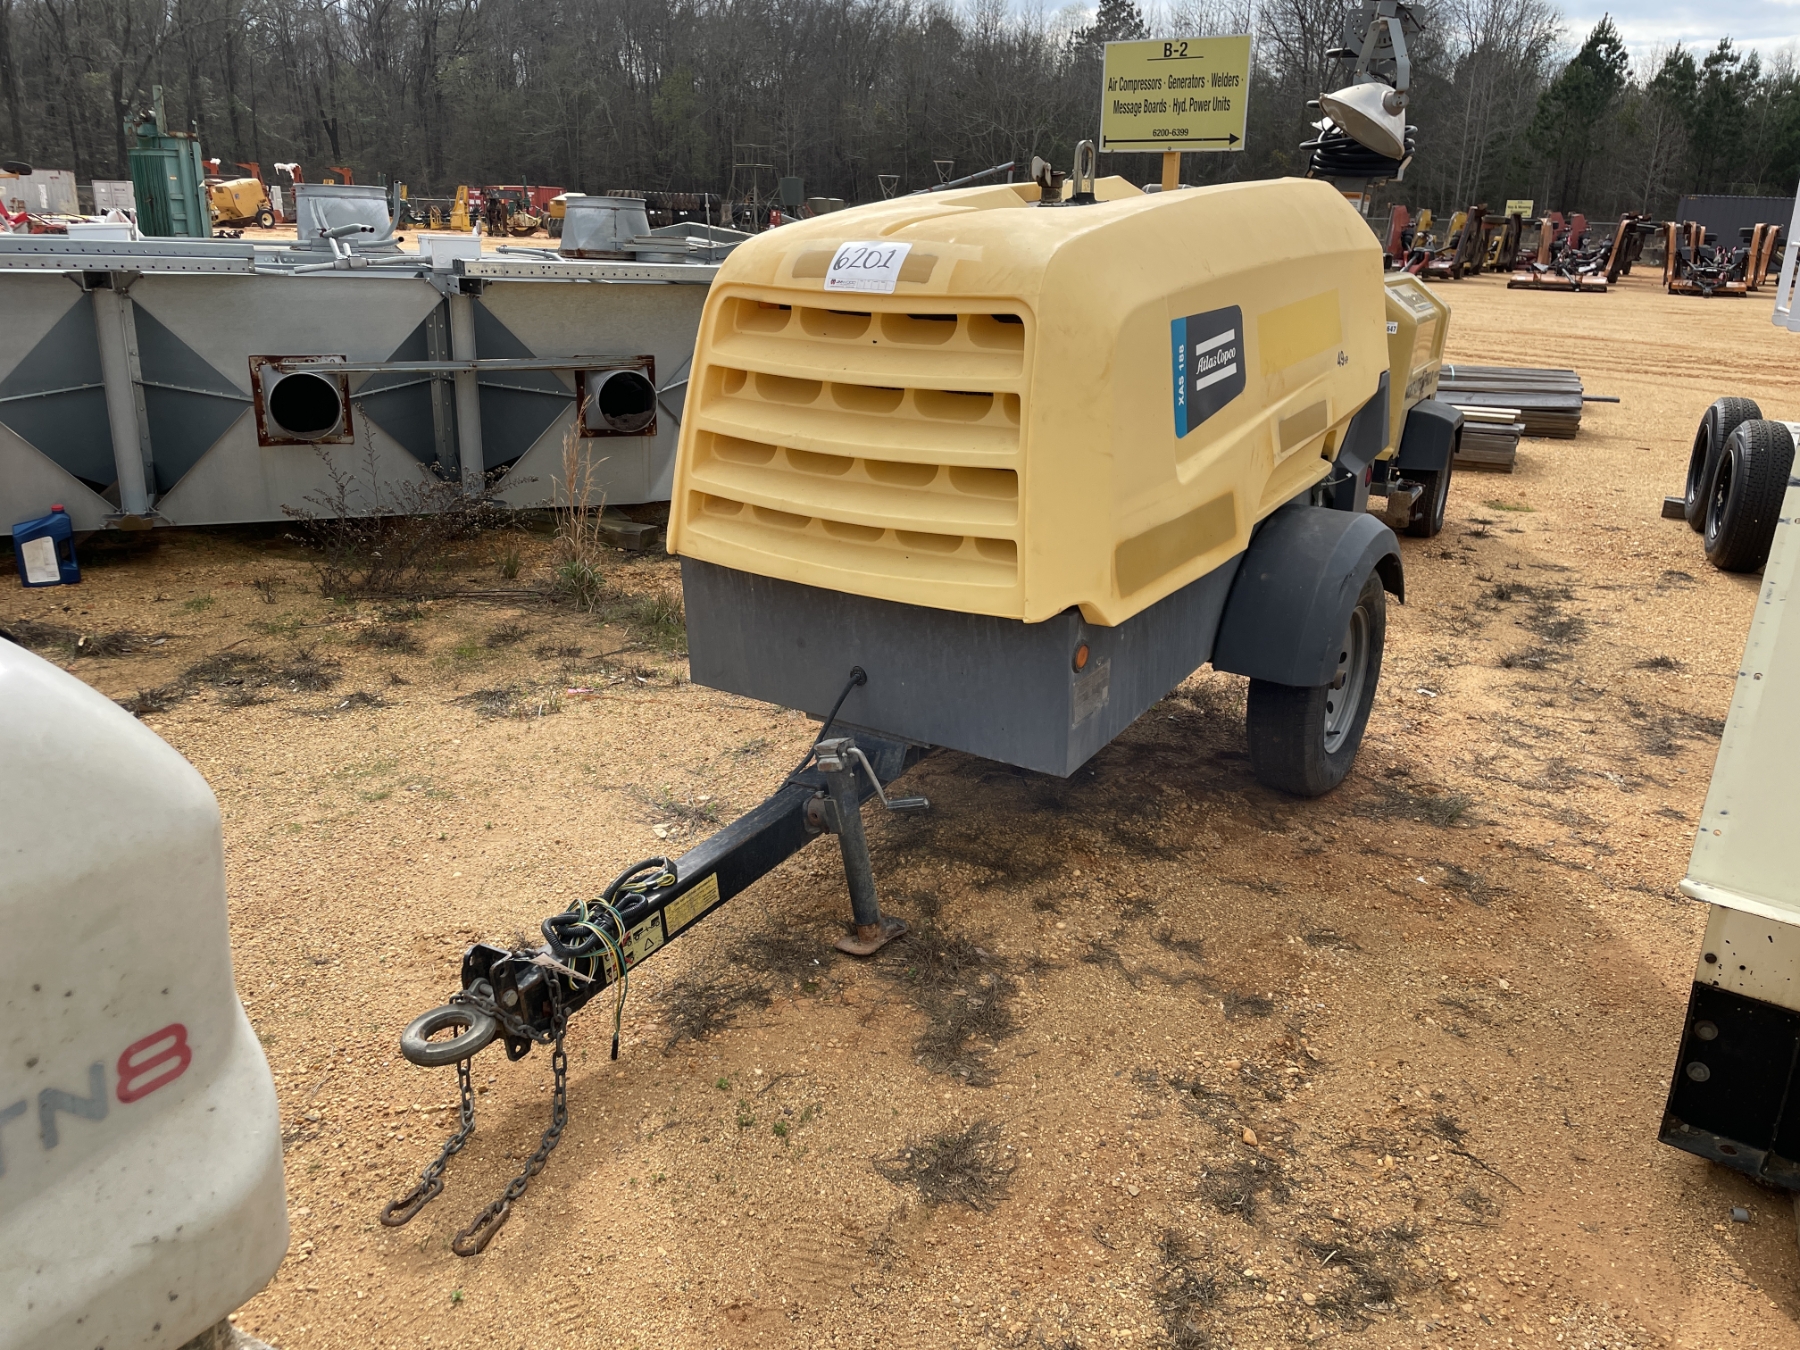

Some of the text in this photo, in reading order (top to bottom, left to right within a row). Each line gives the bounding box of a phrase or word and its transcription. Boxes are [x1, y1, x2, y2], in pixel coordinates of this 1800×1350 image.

[1164, 42, 1188, 57] B-2
[1108, 73, 1239, 93] Air Compressors Generators Welders
[1113, 96, 1231, 117] Message Boards Hyd. Power Units
[1152, 128, 1189, 137] 6200-6399
[833, 247, 897, 270] 6201
[1196, 347, 1236, 375] Atlas Copco
